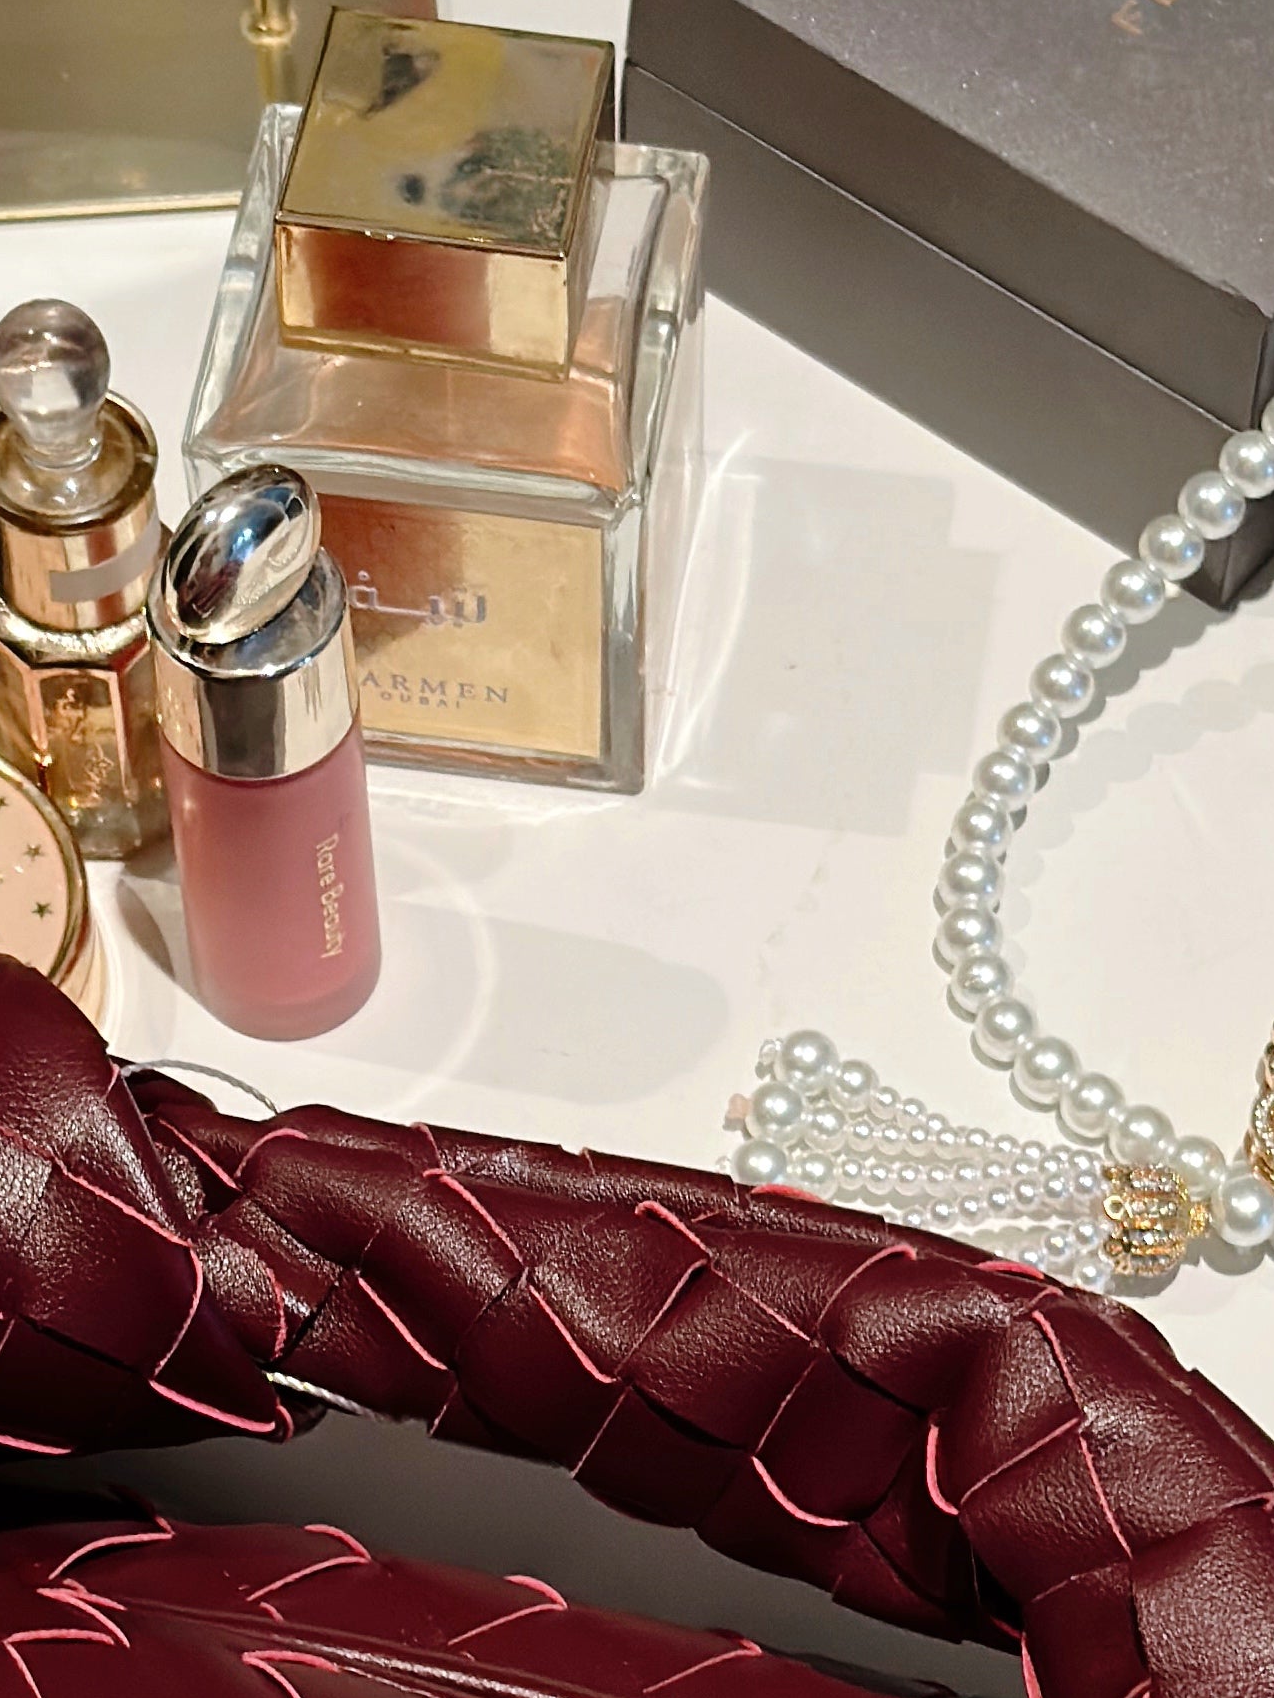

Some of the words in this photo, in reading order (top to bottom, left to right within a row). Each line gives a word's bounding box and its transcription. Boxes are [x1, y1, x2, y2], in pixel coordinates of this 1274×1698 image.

[361, 671, 508, 704] ARMEN
[316, 833, 339, 887] Rare
[320, 882, 345, 958] Beauty
